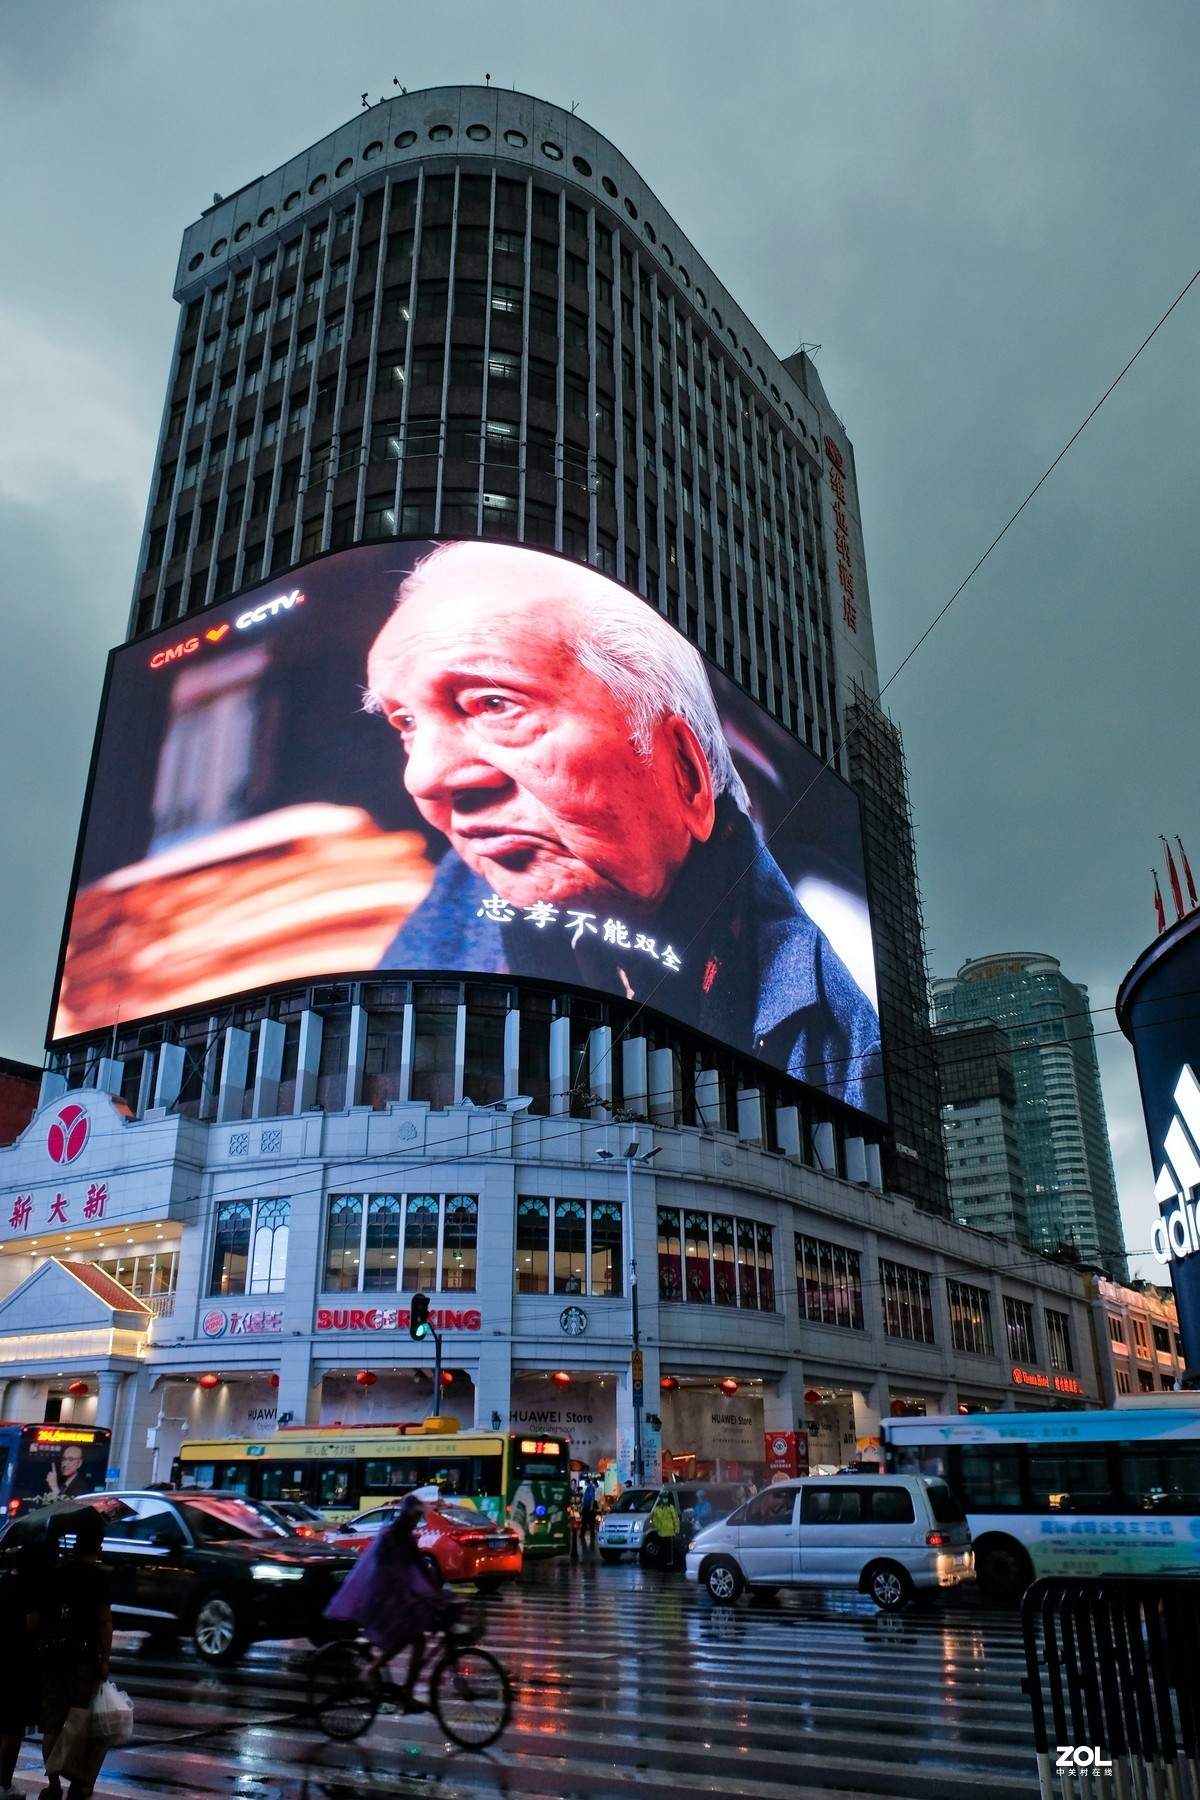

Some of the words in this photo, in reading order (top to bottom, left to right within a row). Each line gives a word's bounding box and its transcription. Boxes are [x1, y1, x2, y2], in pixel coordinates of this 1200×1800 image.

[150, 637, 200, 668] CMG
[235, 589, 300, 630] CCTV
[476, 893, 683, 972] 忠孝不能双全
[8, 1183, 108, 1232] 新大新
[509, 1410, 561, 1423] HUAWEI
[565, 1411, 593, 1424] Store
[711, 1414, 737, 1425] HUAWEI
[737, 1415, 752, 1426] Store
